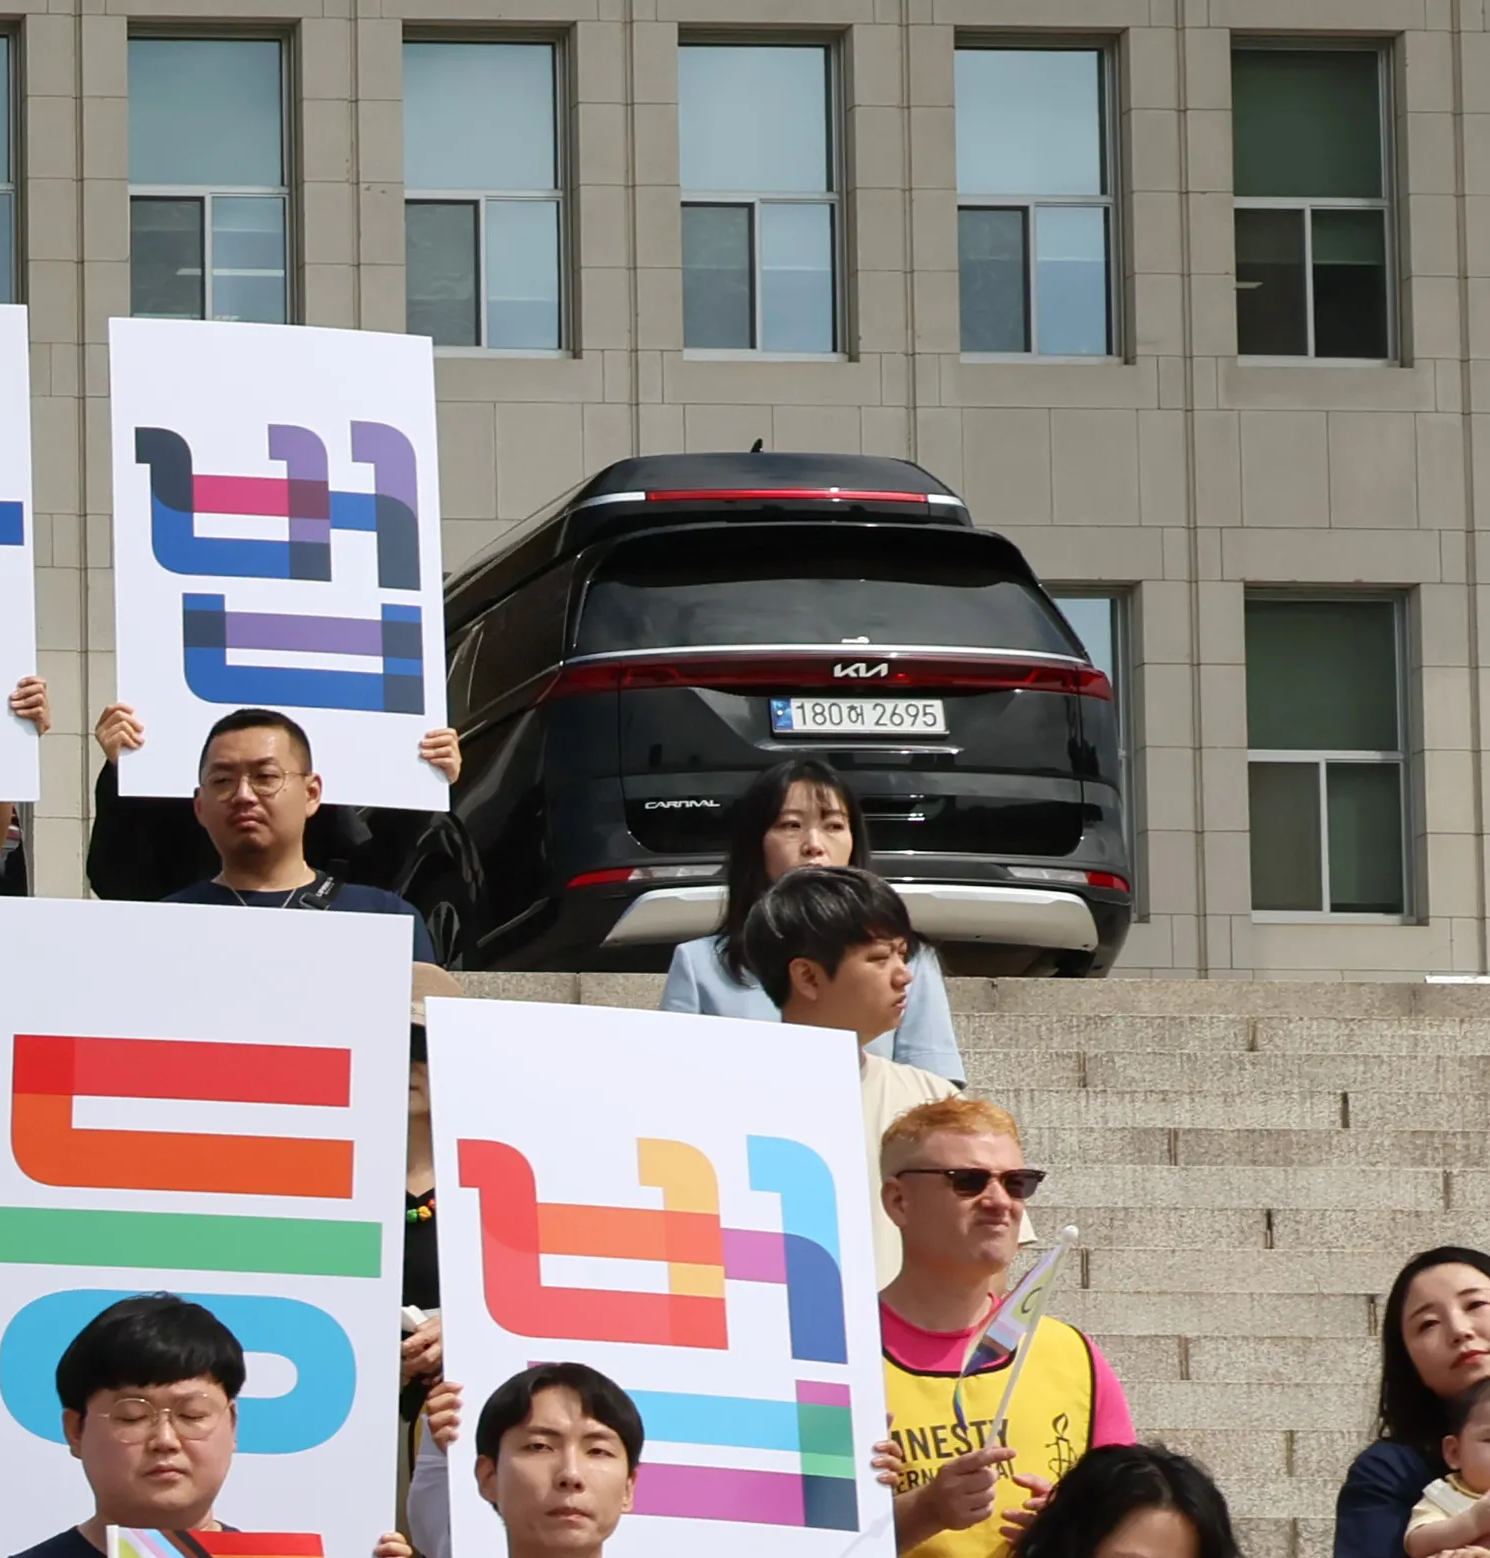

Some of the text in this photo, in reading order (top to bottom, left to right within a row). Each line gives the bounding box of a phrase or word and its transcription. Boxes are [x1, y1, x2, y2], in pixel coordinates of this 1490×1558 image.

[134, 419, 424, 715] 법
[795, 703, 937, 727] 180허 2695
[834, 663, 888, 678] KIA
[457, 1134, 860, 1532] 법
